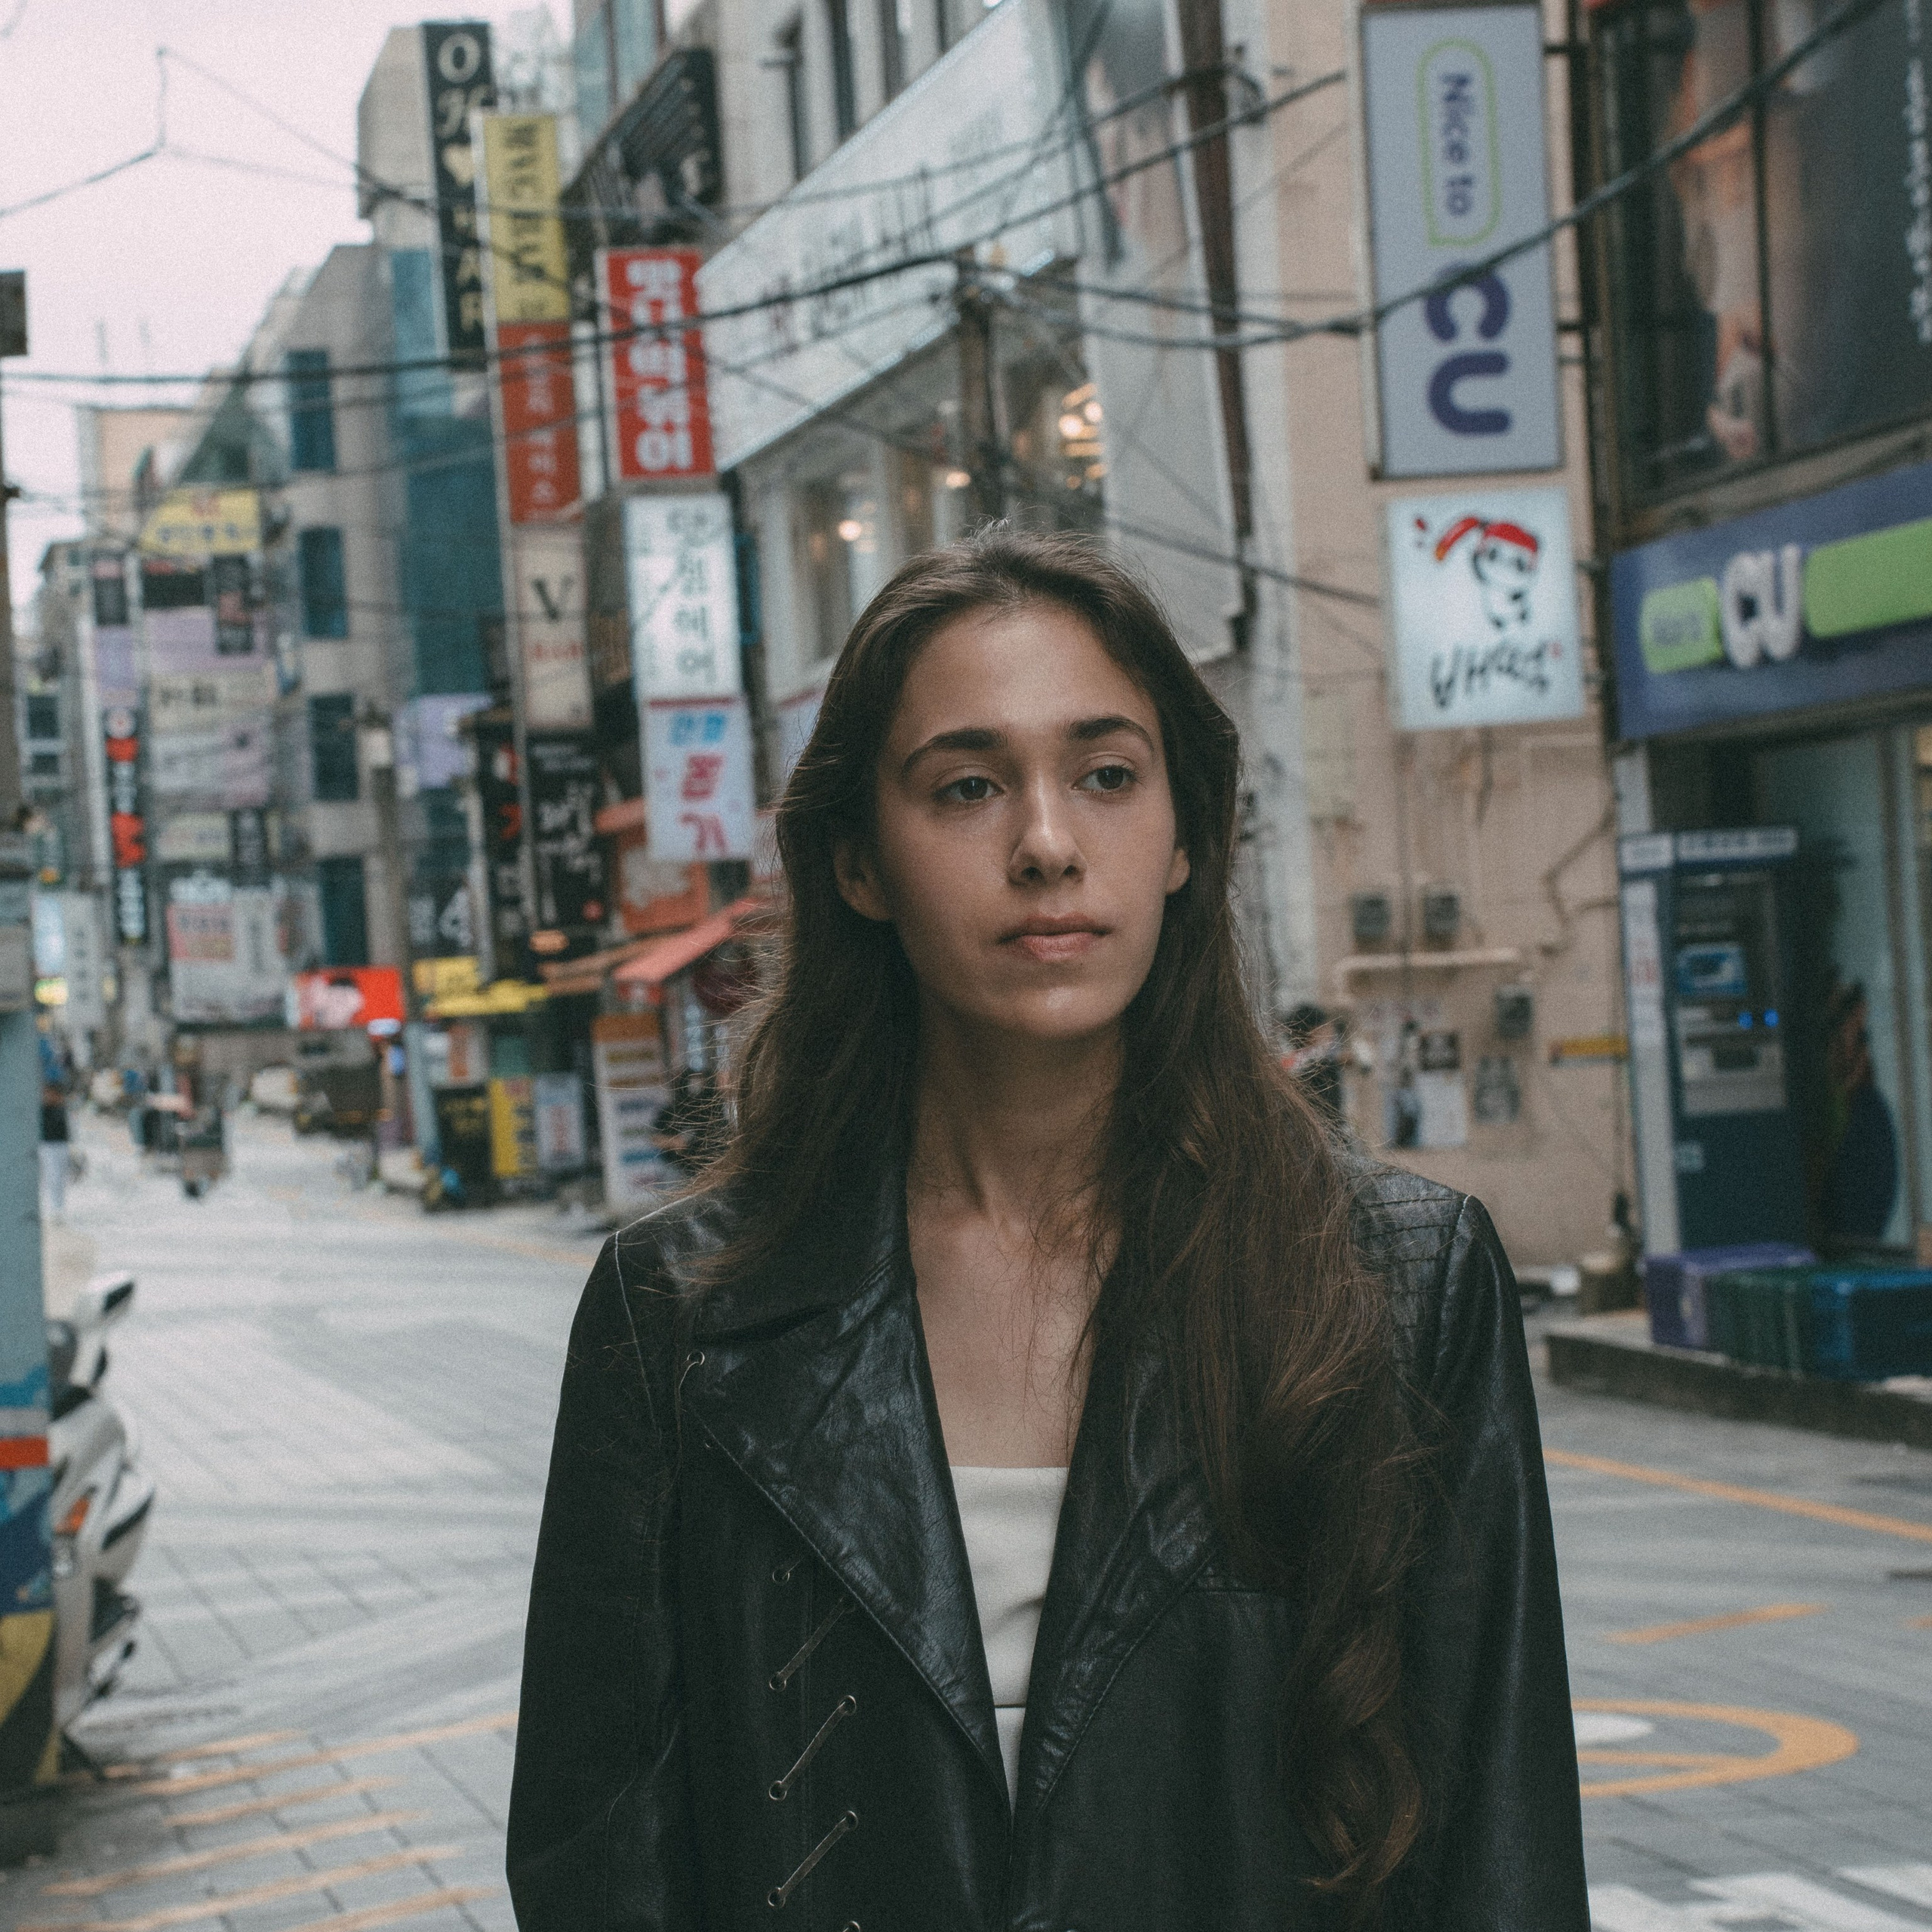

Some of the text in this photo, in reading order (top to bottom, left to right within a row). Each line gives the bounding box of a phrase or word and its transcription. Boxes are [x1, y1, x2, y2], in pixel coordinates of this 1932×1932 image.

[1442, 72, 1475, 218] Nice to
[1423, 262, 1512, 437] CU
[1719, 543, 1803, 669] CU
